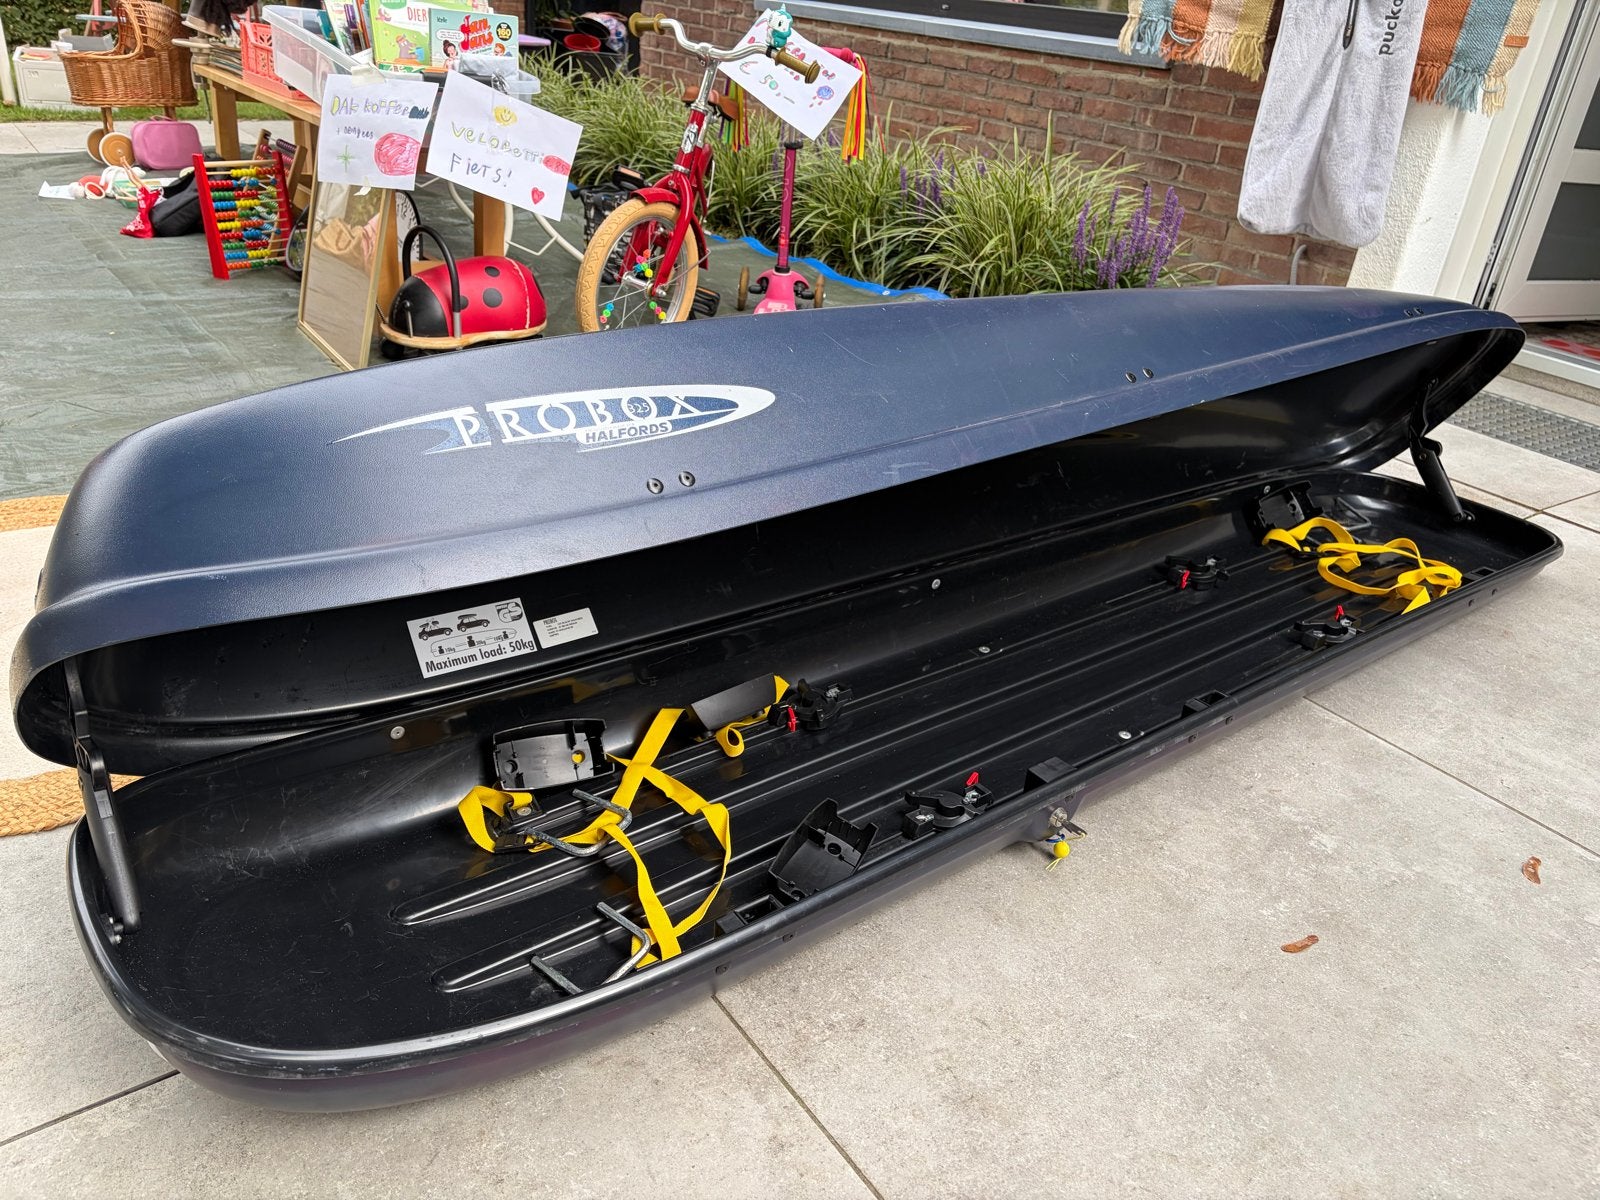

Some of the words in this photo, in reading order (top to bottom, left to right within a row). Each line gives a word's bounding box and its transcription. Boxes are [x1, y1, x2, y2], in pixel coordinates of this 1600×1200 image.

[448, 393, 704, 448] PROBOX
[626, 402, 650, 415] 325
[584, 421, 670, 443] HALFORDS
[425, 650, 478, 674] Maximum
[479, 643, 508, 660] load:
[509, 639, 535, 656] 50kg
